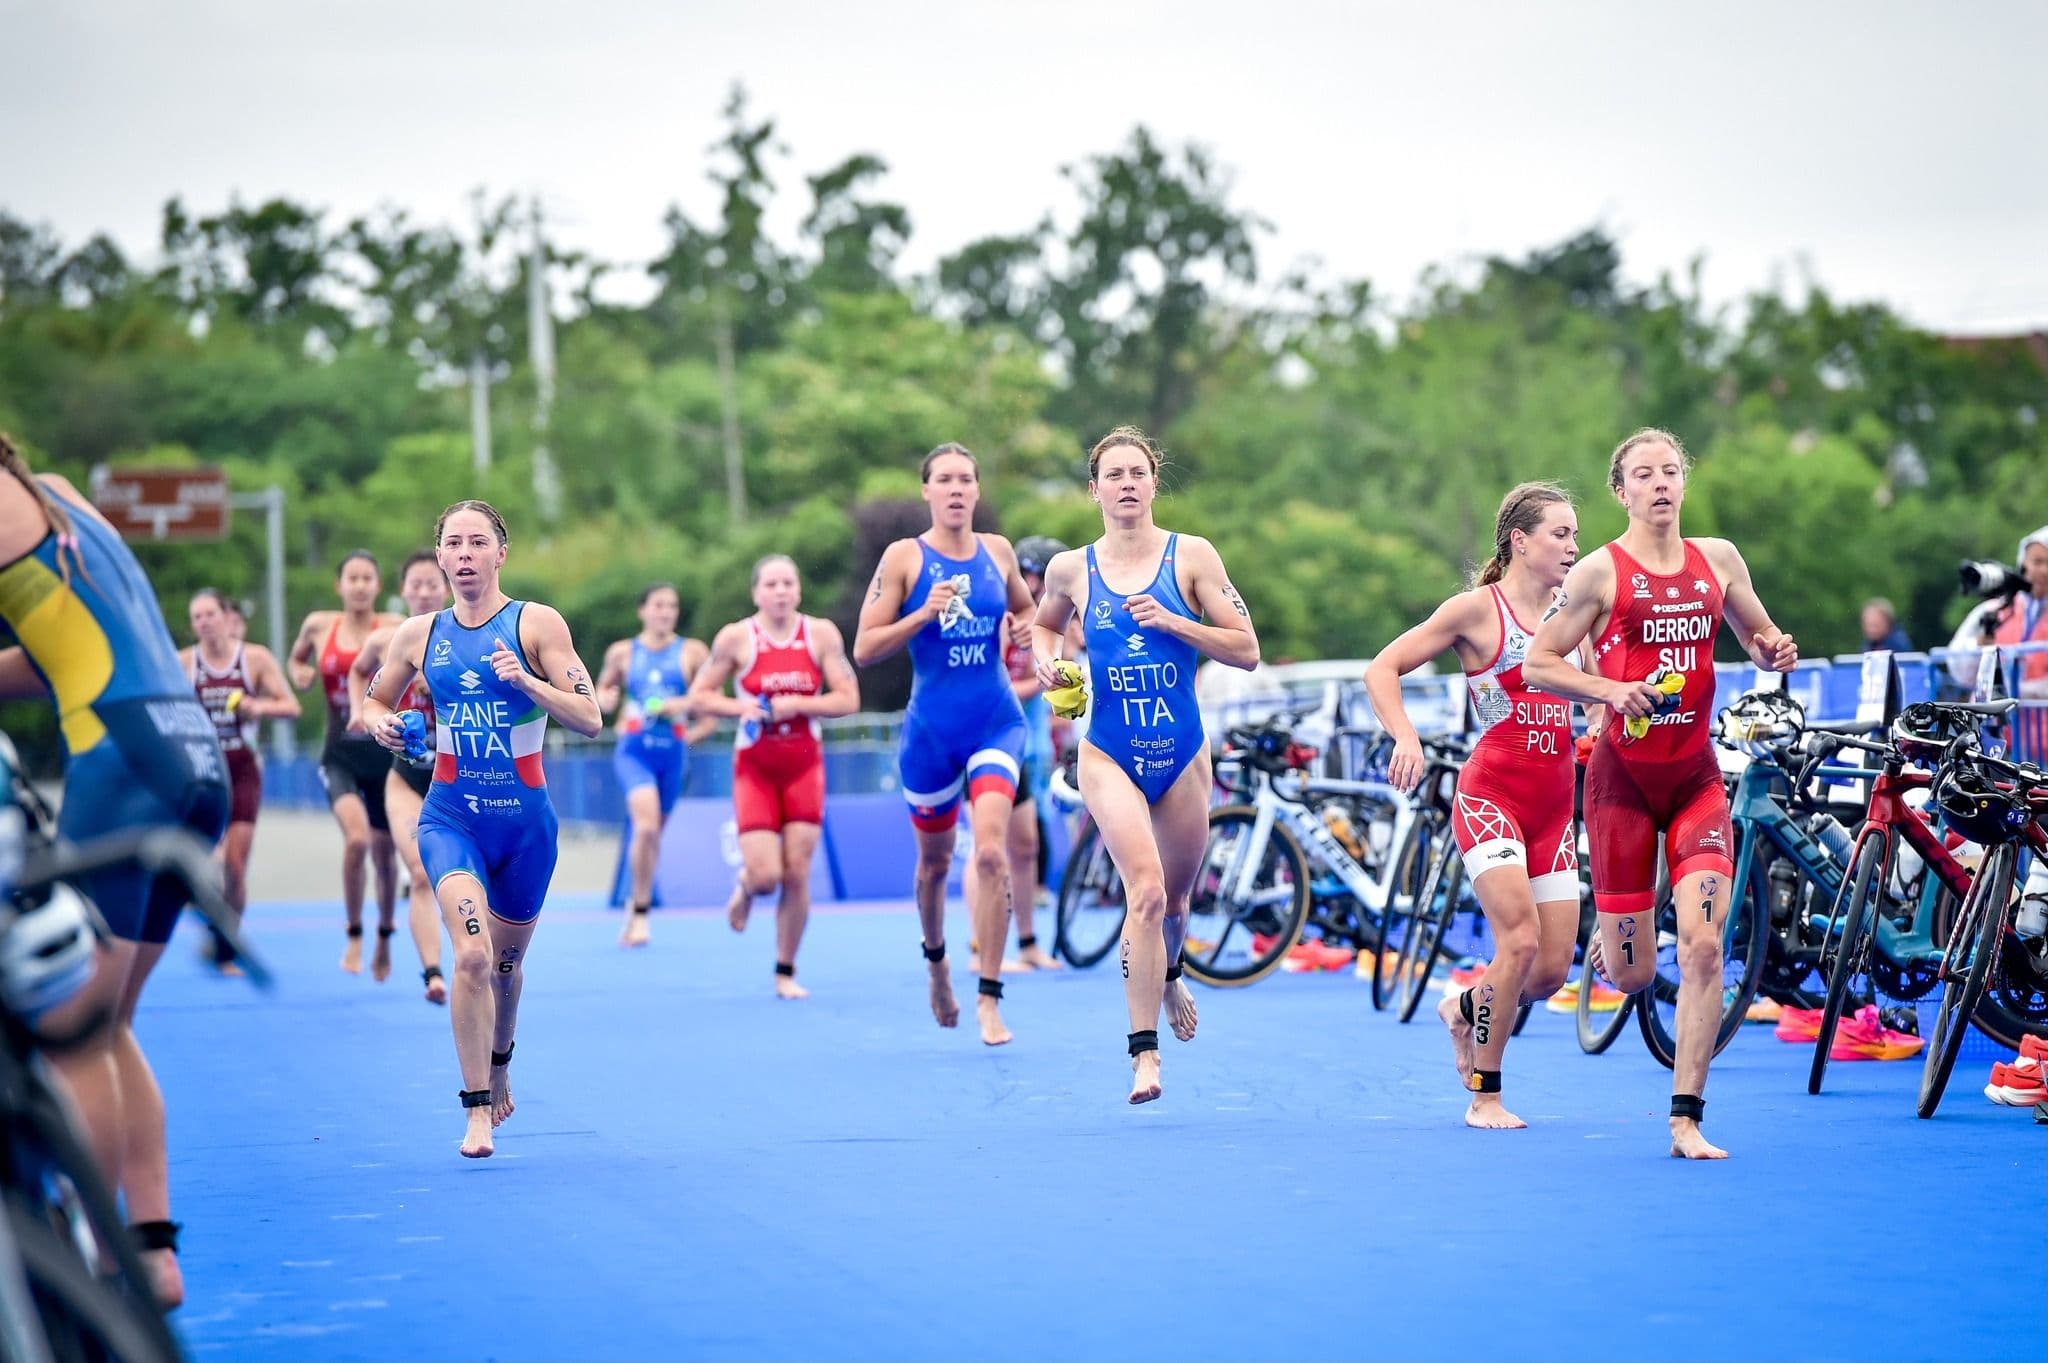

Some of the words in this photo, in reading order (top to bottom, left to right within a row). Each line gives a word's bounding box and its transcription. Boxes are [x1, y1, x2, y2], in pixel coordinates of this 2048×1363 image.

[1232, 601, 1247, 616] 5
[1661, 601, 1705, 612] DESCENTE
[1643, 615, 1712, 643] DERRON
[948, 643, 986, 667] SVK
[1659, 647, 1697, 672] SUI
[1107, 662, 1178, 692] BETTO
[447, 701, 511, 728] ZANE
[1122, 696, 1175, 728] ITA
[1516, 702, 1568, 727] SLUPEK
[1650, 711, 1696, 725] BMC
[454, 731, 511, 759] ITA
[1130, 733, 1175, 749] dorelan
[1527, 730, 1558, 754] POL
[459, 764, 514, 780] dorelan
[1146, 758, 1175, 769] THEMA
[482, 798, 520, 807] THEMA
[1700, 899, 1712, 923] 1
[465, 918, 480, 935] 6
[1621, 942, 1634, 967] 1
[498, 961, 514, 973] 6
[1121, 960, 1129, 979] 5
[1476, 1005, 1491, 1045] 23
